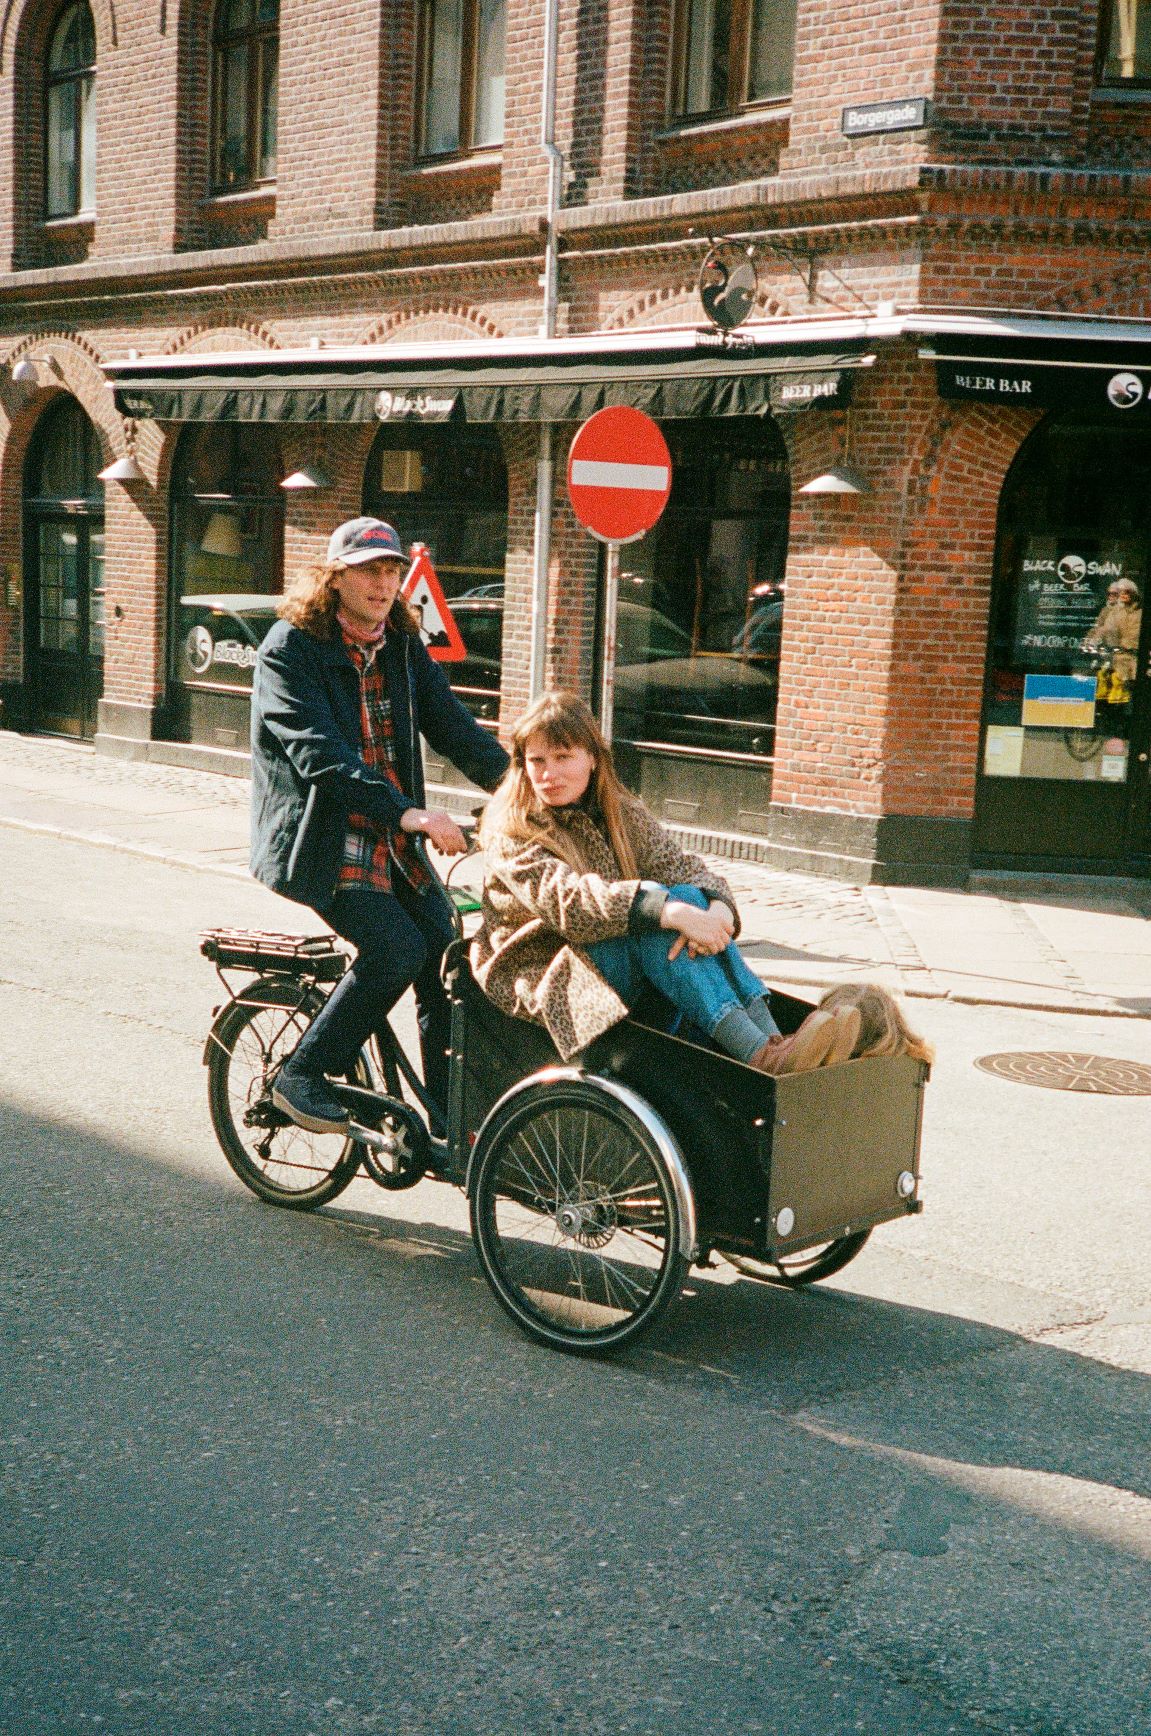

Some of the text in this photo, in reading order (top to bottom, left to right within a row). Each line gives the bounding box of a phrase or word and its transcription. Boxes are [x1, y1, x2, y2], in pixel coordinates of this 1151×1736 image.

[848, 105, 917, 126] Borgergade
[781, 382, 838, 399] BEER BAR
[955, 375, 1032, 393] BEER BAR
[1023, 560, 1122, 576] BLACK SWAN
